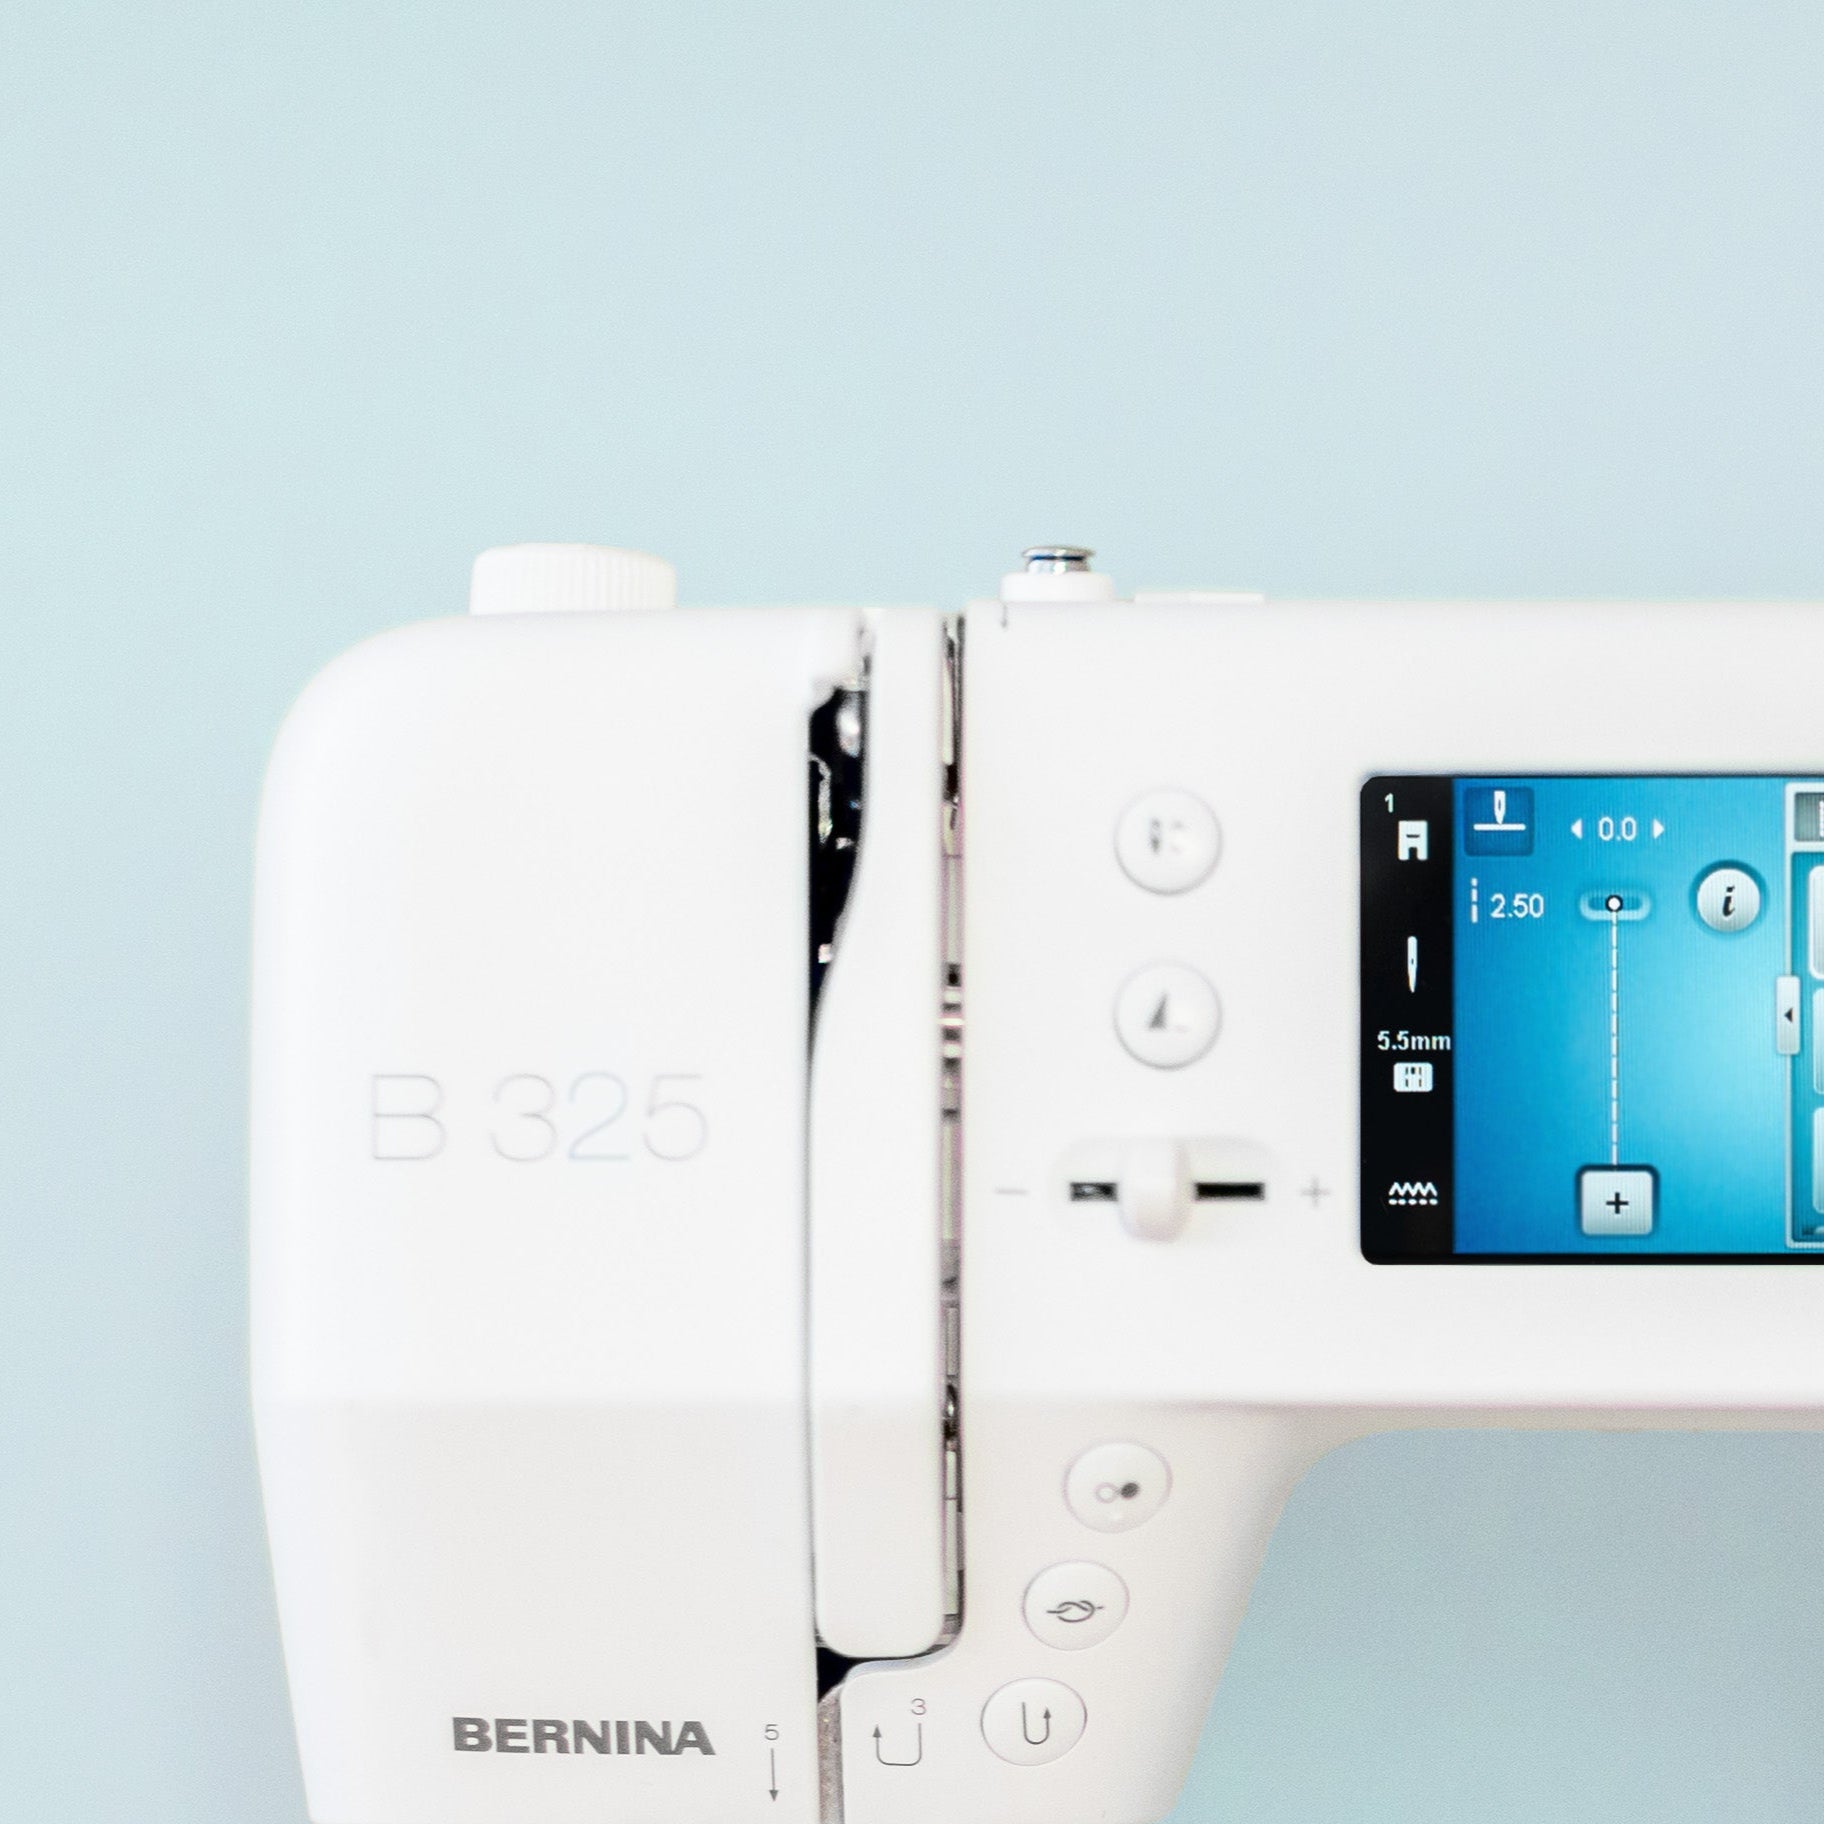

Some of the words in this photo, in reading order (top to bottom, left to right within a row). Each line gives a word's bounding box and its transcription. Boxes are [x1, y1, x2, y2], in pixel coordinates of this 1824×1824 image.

[1383, 792, 1394, 813] 1
[1598, 816, 1637, 841] 0.0
[1490, 893, 1544, 918] 2.50
[1720, 884, 1738, 917] i
[1377, 1030, 1451, 1051] 5.5mm
[371, 1072, 447, 1162] B
[489, 1070, 710, 1164] 325
[911, 1697, 928, 1716] 3
[452, 1716, 716, 1756] BERNINA
[764, 1723, 780, 1741] 5
